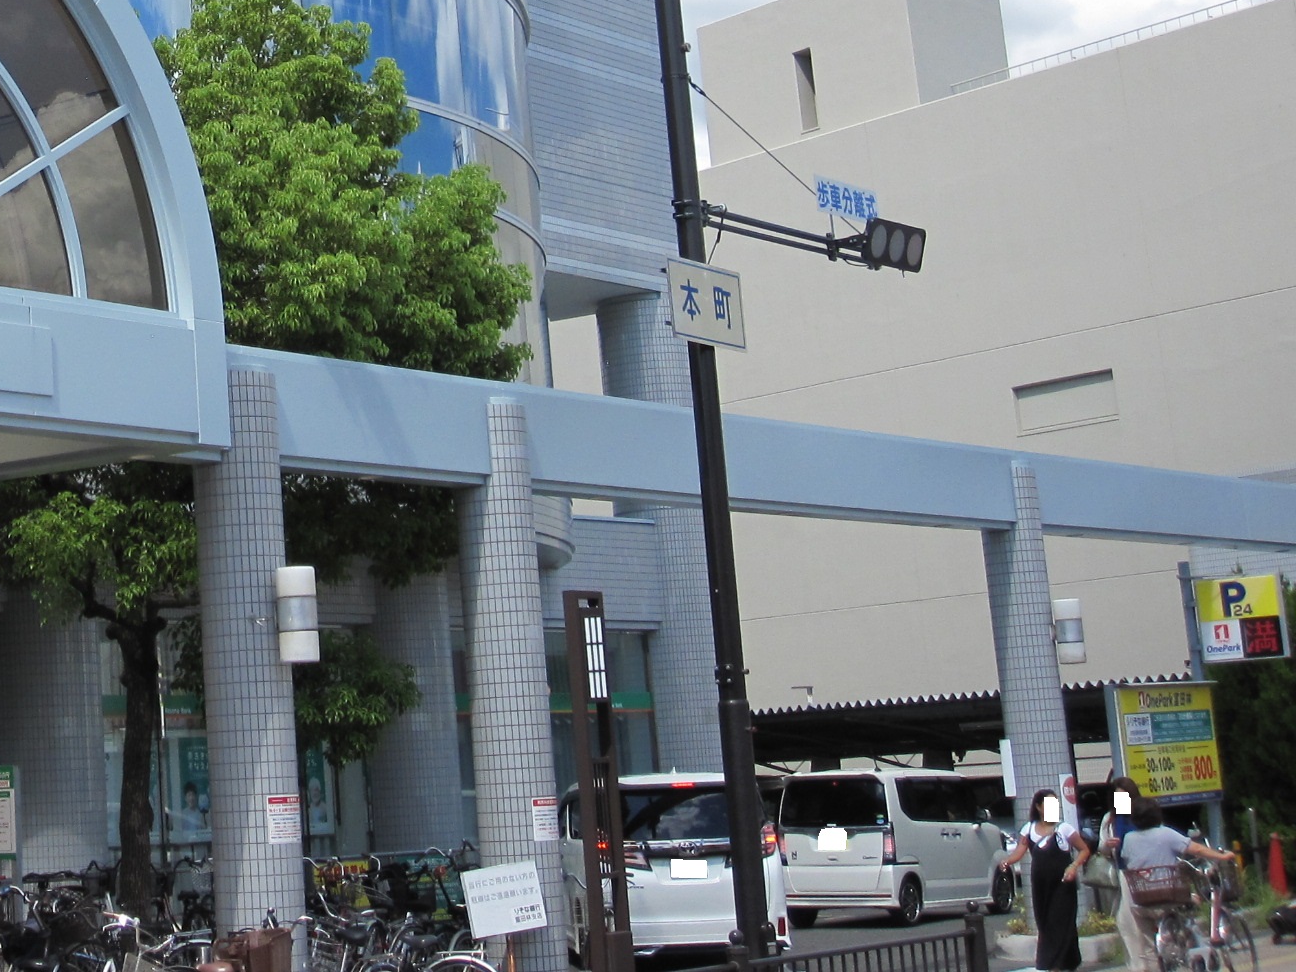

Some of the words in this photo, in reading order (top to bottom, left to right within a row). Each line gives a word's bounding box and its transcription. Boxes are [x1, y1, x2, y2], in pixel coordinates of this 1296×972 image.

[817, 181, 878, 219] 歩車分離式
[680, 278, 732, 330] 本町
[1219, 581, 1246, 618] P
[1233, 604, 1253, 617] 24
[1207, 644, 1241, 654] OnePark
[1247, 621, 1278, 653] 満
